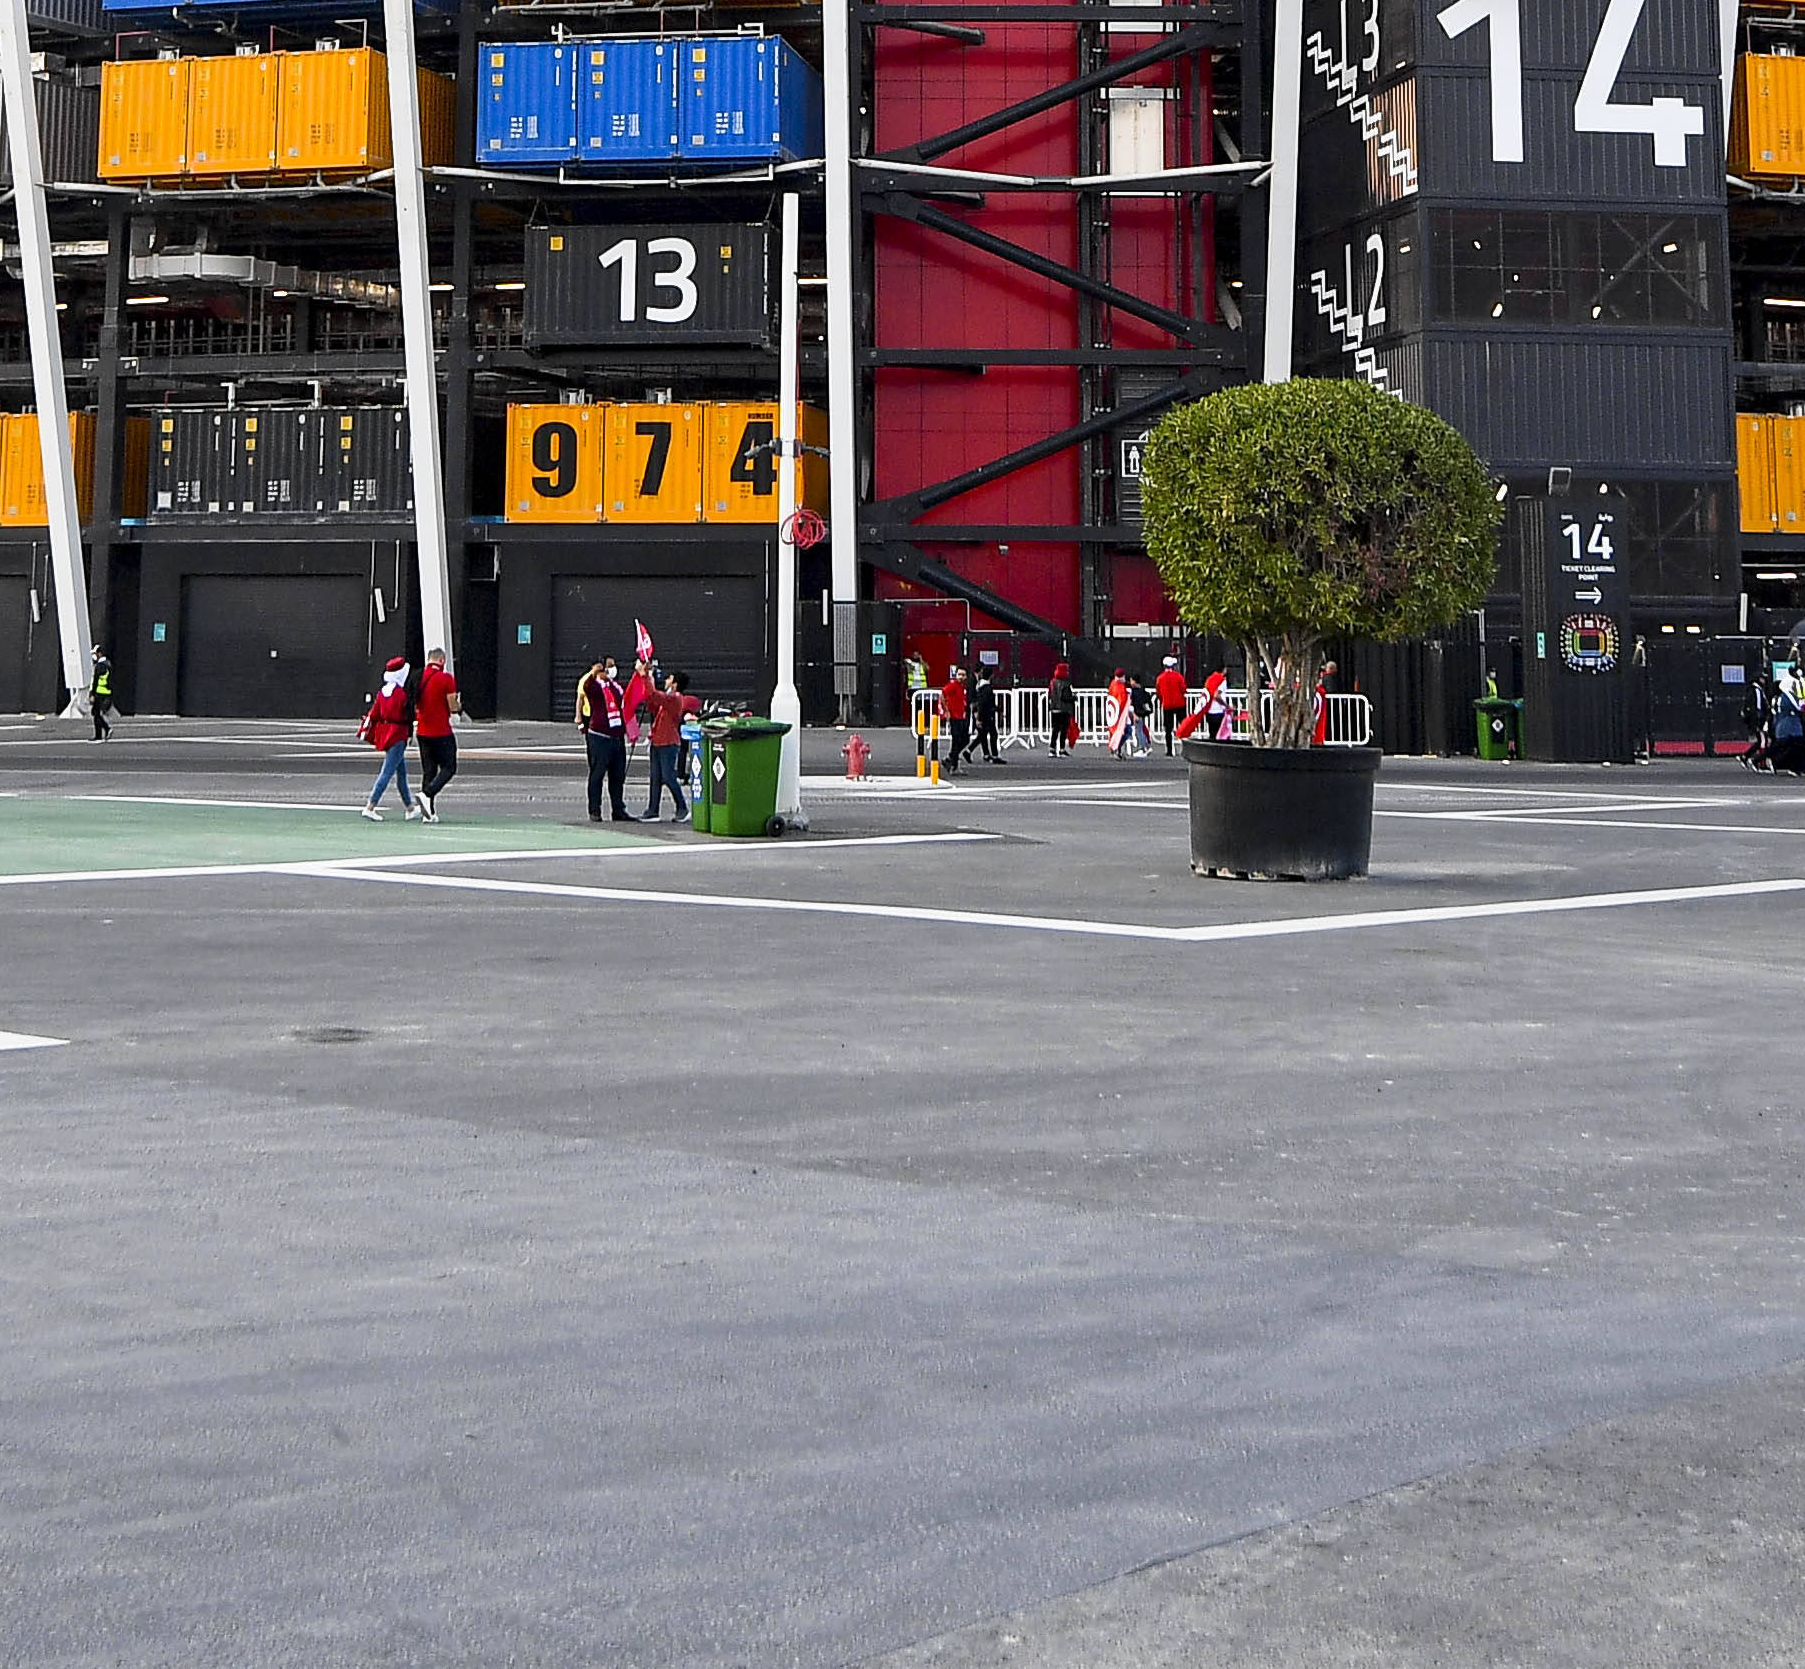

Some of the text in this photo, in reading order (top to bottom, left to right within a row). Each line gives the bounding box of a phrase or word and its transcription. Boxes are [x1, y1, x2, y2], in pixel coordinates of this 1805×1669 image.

[598, 237, 697, 323] 13
[1344, 233, 1386, 335] L2
[1562, 523, 1614, 560] 14
